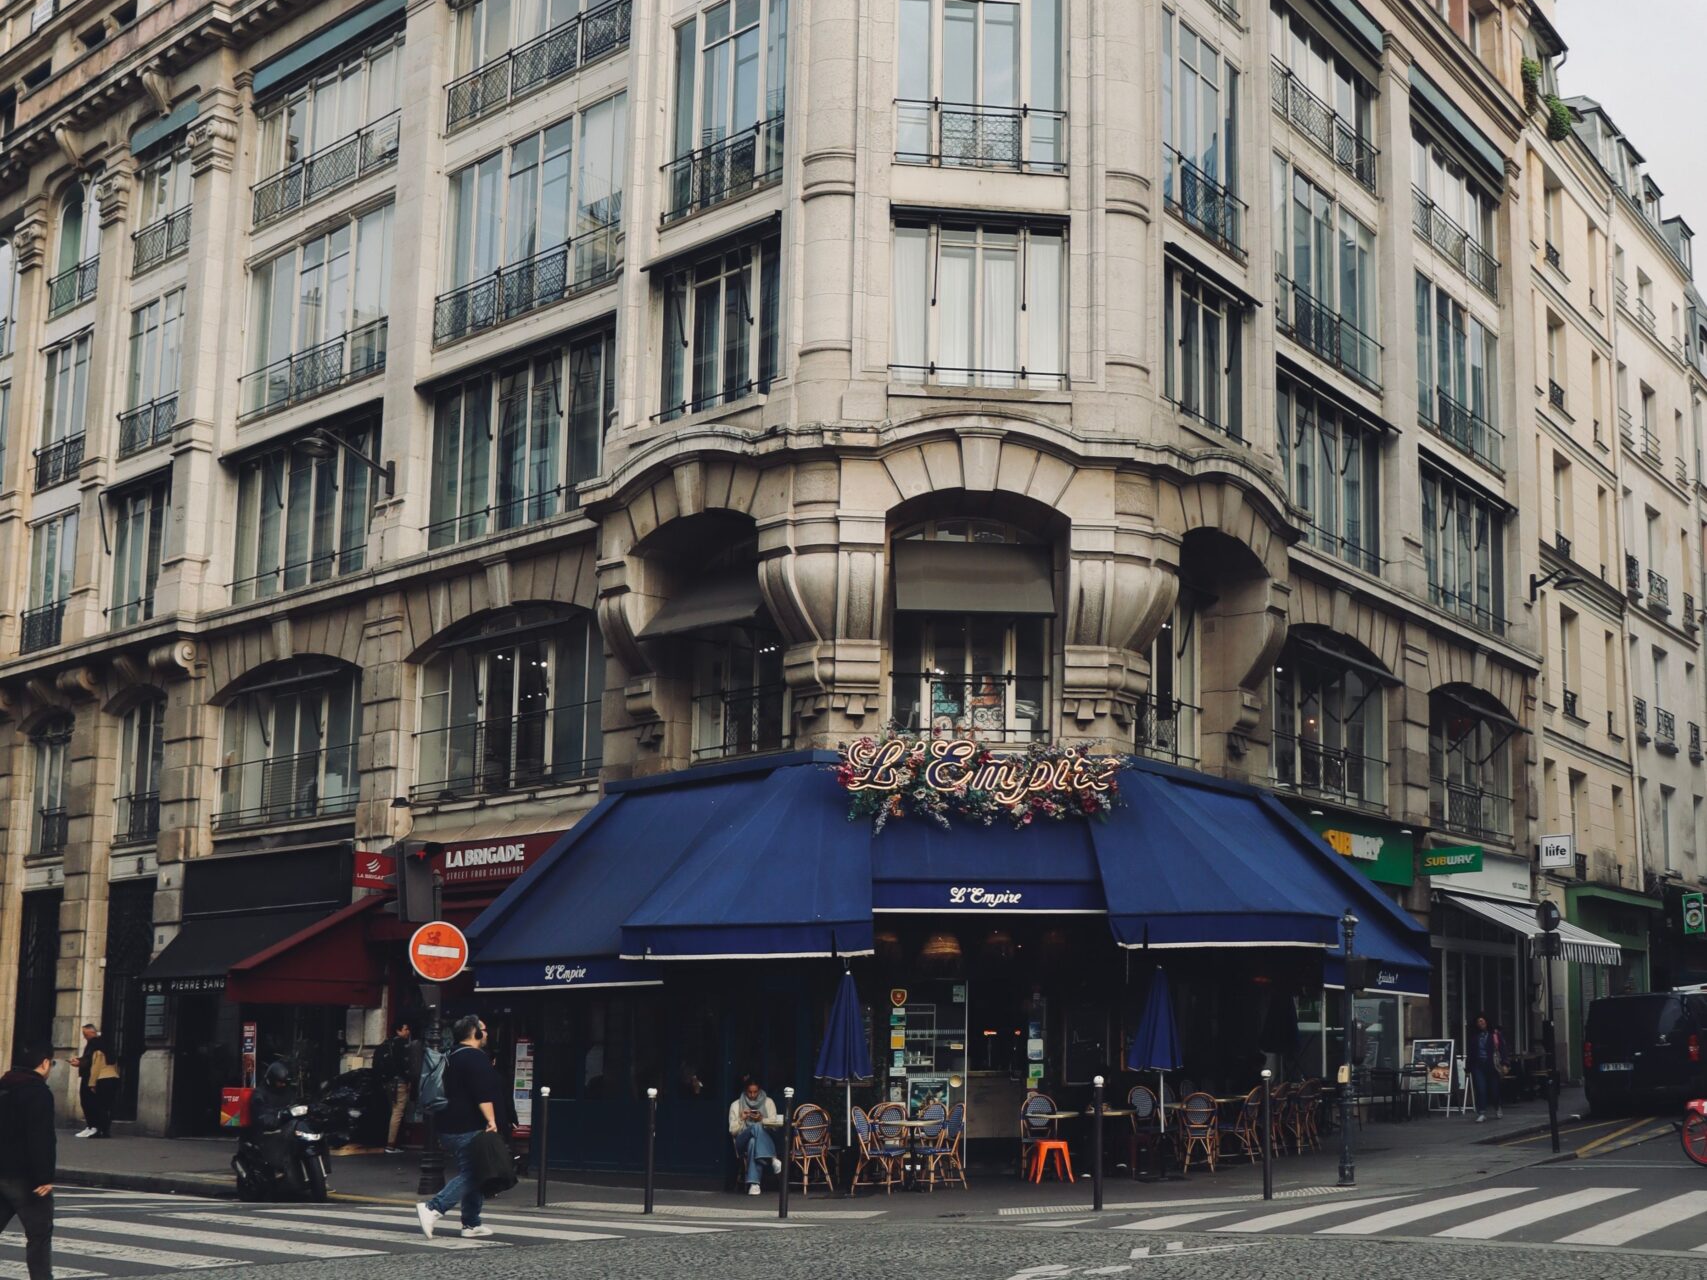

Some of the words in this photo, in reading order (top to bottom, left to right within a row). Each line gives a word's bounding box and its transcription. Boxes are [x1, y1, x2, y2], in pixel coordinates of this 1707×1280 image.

[848, 740, 1120, 804] L'Empire
[1321, 828, 1385, 861] SUBWAY
[446, 851, 463, 868] LA
[464, 843, 525, 866] BRIGADE
[1424, 853, 1475, 867] SUBWAY
[446, 871, 468, 880] STREET
[471, 869, 487, 878] FOOD
[489, 865, 524, 876] CARNIVORE
[949, 887, 1022, 907] L'Empire
[544, 964, 587, 983] L'Empire
[171, 981, 200, 990] PIERRE
[203, 979, 225, 989] SANG
